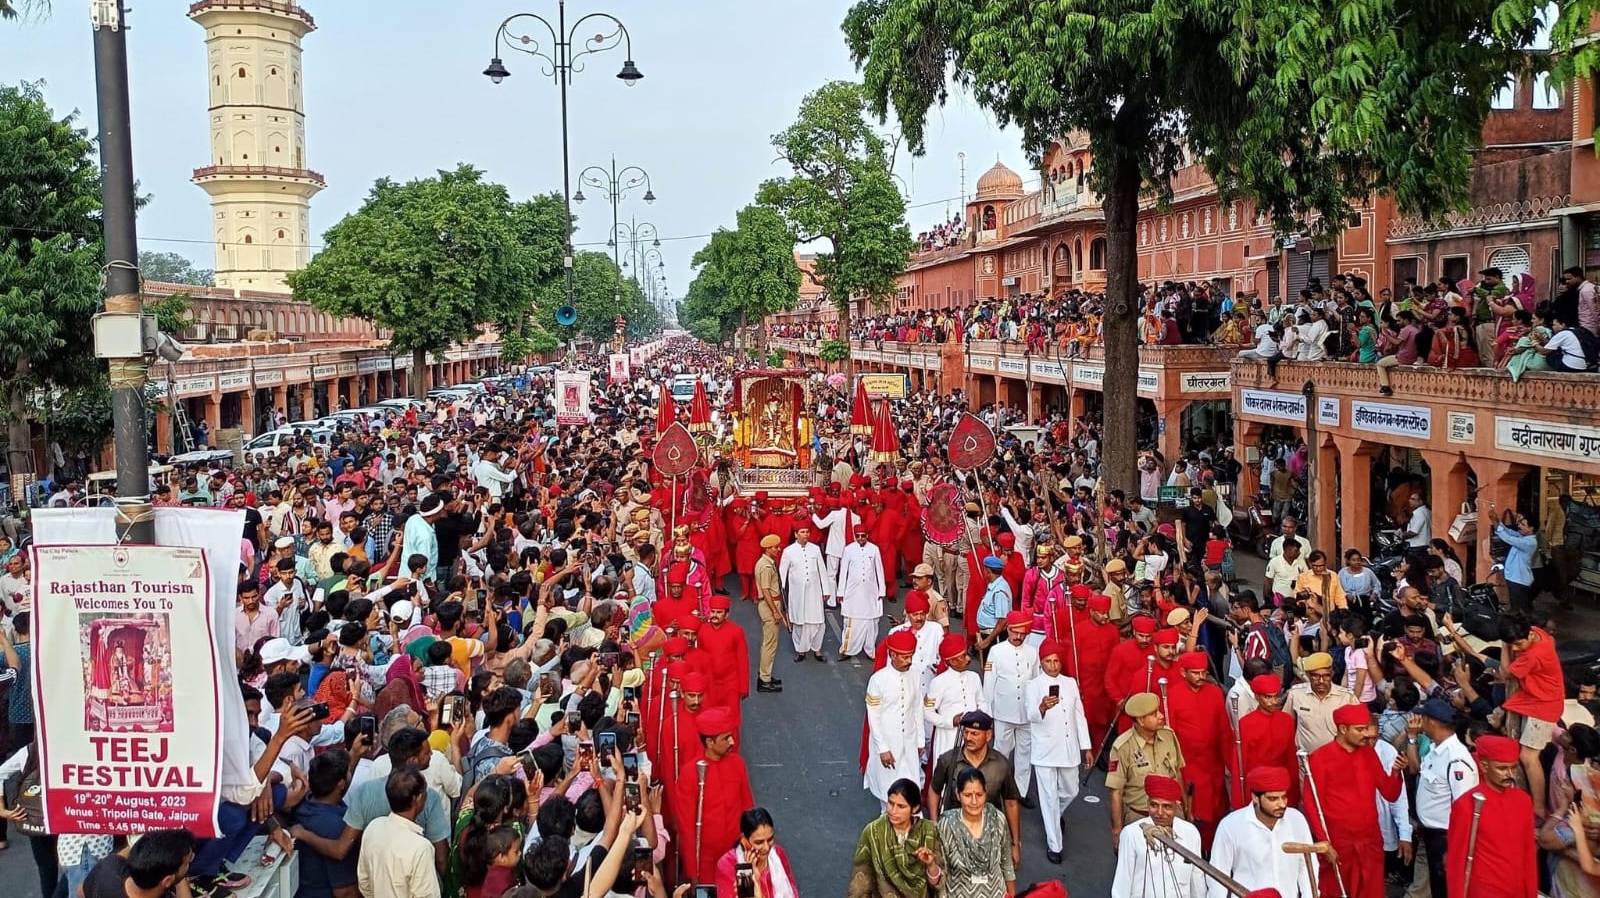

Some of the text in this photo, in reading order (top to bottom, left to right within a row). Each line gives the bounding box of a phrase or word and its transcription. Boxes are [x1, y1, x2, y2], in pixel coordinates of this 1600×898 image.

[1355, 406, 1377, 425] इण्डियन
[1511, 424, 1576, 451] बद्रीनारायण
[50, 580, 194, 596] Rajasthan Tourism
[74, 597, 173, 609] Welcomes You To
[90, 736, 168, 762] TEEJ
[62, 763, 203, 788] FESTIVAL
[115, 794, 157, 808] August,
[160, 796, 187, 807] 2023
[64, 806, 93, 817] Venue
[102, 807, 139, 819] Tripolia
[141, 809, 166, 821] Gate,
[168, 811, 200, 823] Jaipur
[77, 820, 101, 830] Time
[108, 822, 129, 831] 5.45
[130, 823, 146, 832] PM
